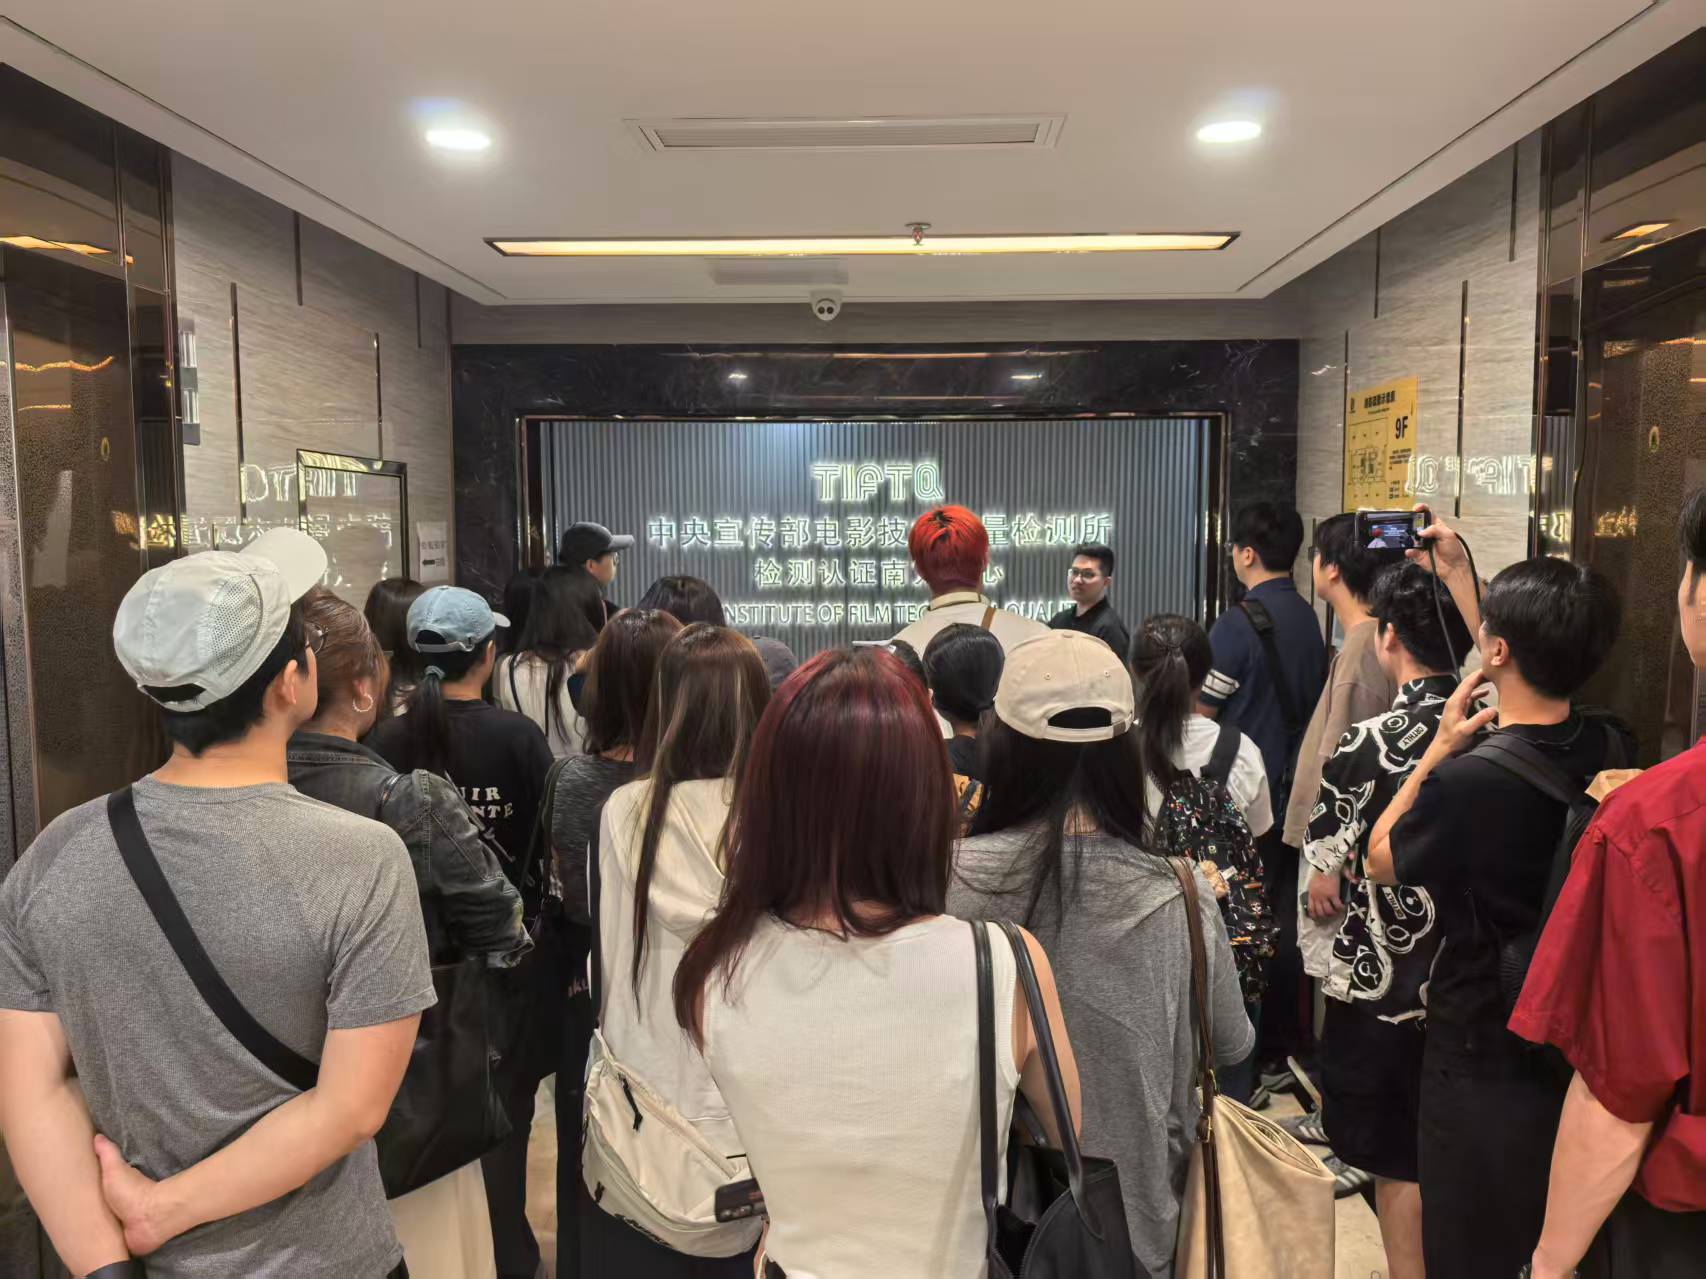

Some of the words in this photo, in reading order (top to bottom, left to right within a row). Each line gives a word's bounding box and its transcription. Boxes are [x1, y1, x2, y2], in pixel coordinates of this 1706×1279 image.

[1395, 415, 1409, 440] 9F
[648, 514, 1114, 548] 中央宣传部电影技量检测所
[755, 557, 1004, 587] 检测认证南心
[724, 602, 814, 625] NSTITUTE
[817, 602, 844, 625] OF
[847, 602, 891, 625] FILM
